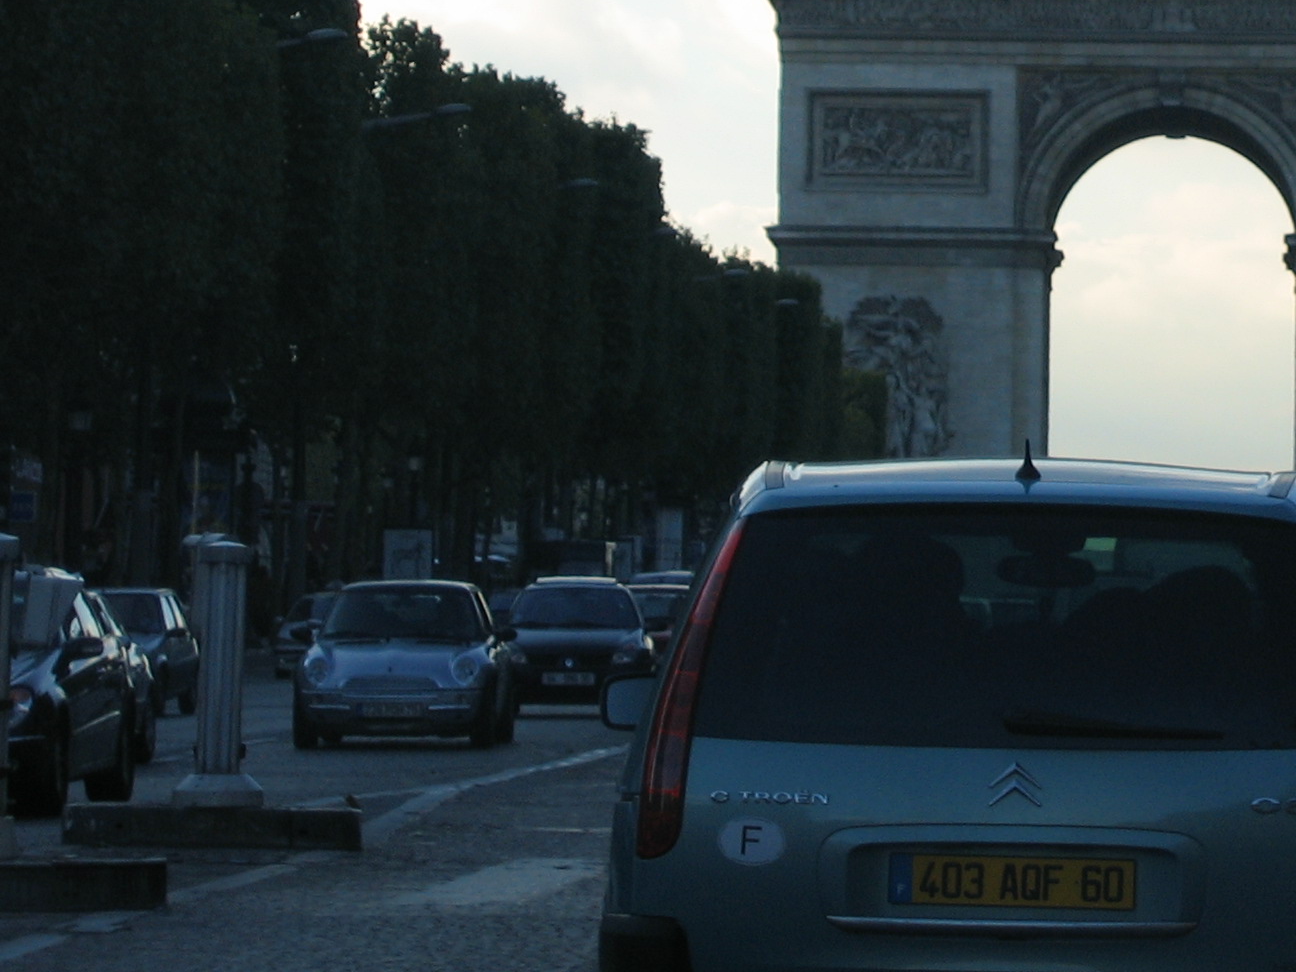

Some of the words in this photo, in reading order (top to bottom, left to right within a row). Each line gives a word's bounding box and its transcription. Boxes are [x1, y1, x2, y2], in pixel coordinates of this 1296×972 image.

[709, 789, 829, 805] CTROËN
[740, 825, 763, 855] F
[919, 861, 985, 899] 403
[1000, 863, 1063, 901] AQF
[1081, 865, 1124, 903] 60
